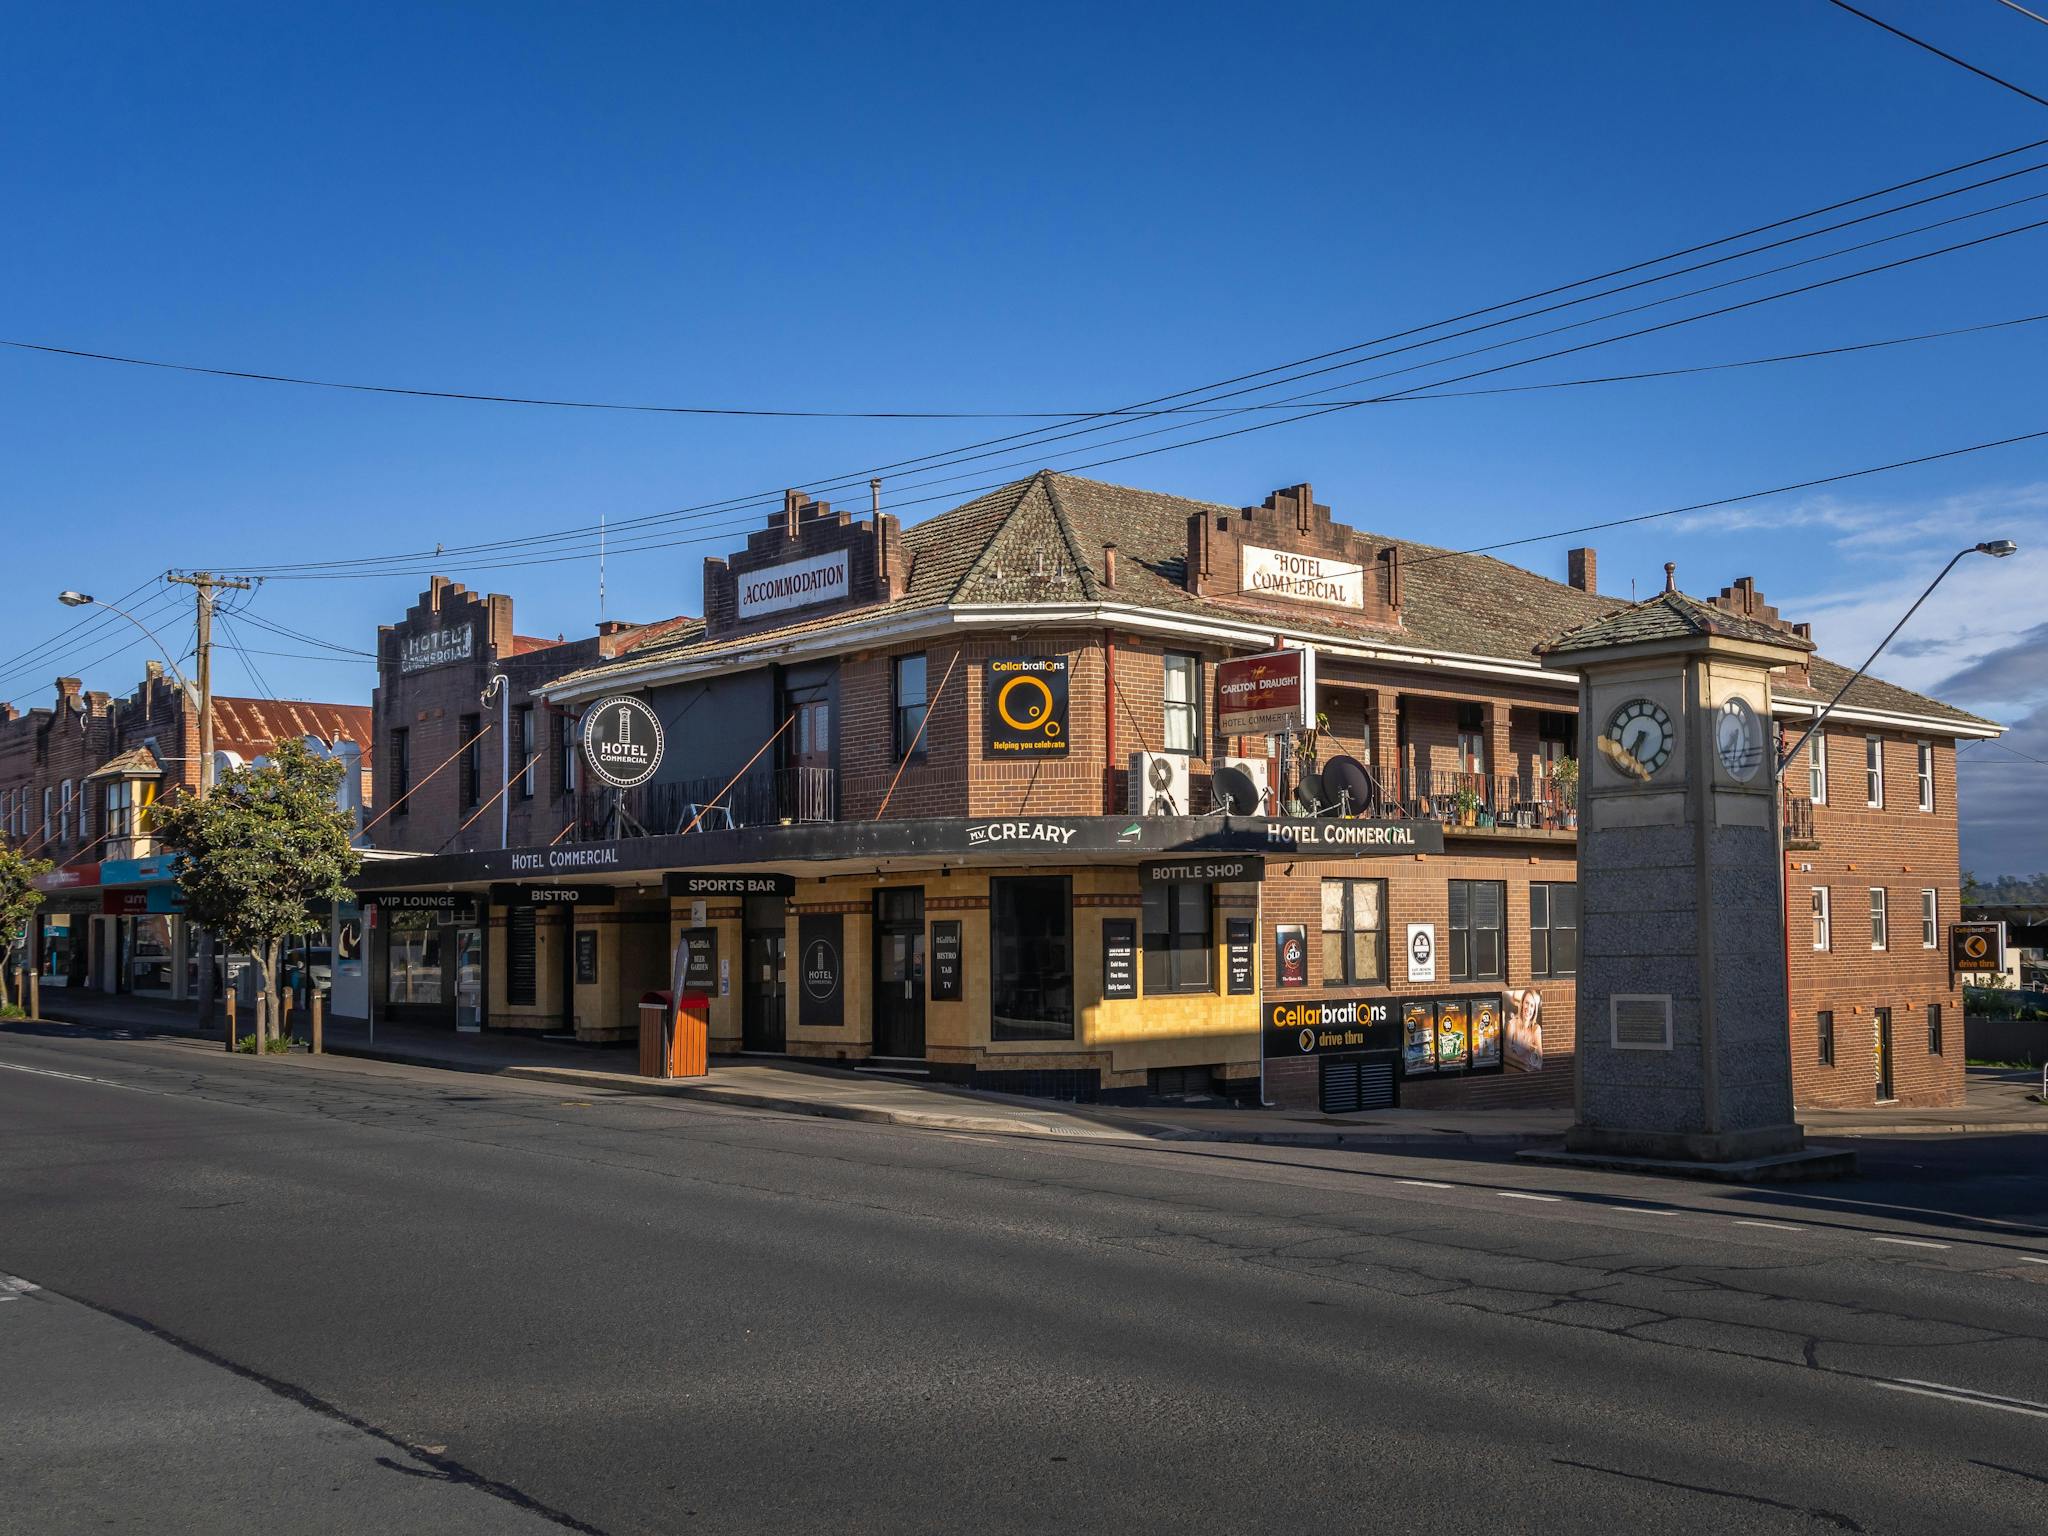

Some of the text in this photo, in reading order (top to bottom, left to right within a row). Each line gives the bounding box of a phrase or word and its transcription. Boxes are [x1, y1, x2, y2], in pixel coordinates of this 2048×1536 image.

[1274, 553, 1324, 578] HOTEL
[743, 564, 844, 605] ACCOMMODATION
[1252, 570, 1346, 602] COMMERCIAL
[1221, 676, 1298, 695] CARLTON DRAUGHT
[1222, 717, 1246, 728] HOTEL
[601, 742, 648, 757] HOTEL
[993, 741, 1066, 751] Helping you celebrate
[600, 754, 648, 764] COMMERCIAL
[987, 822, 1077, 845] CREARY
[1267, 823, 1320, 844] HOTEL
[512, 848, 618, 870] HOTEL COMMERCIAL
[1152, 863, 1244, 880] BOTTLE SHOP
[689, 879, 776, 892] SPORTS BAR
[379, 896, 456, 907] VIP LOUNGE
[531, 890, 579, 901] BISTRO
[1286, 950, 1300, 960] OLD
[1958, 959, 1978, 968] drive
[808, 971, 833, 979] HOTEL
[943, 981, 952, 989] TV
[1273, 1002, 1387, 1027] Cellarbrations
[1319, 1029, 1364, 1047] drive thru
